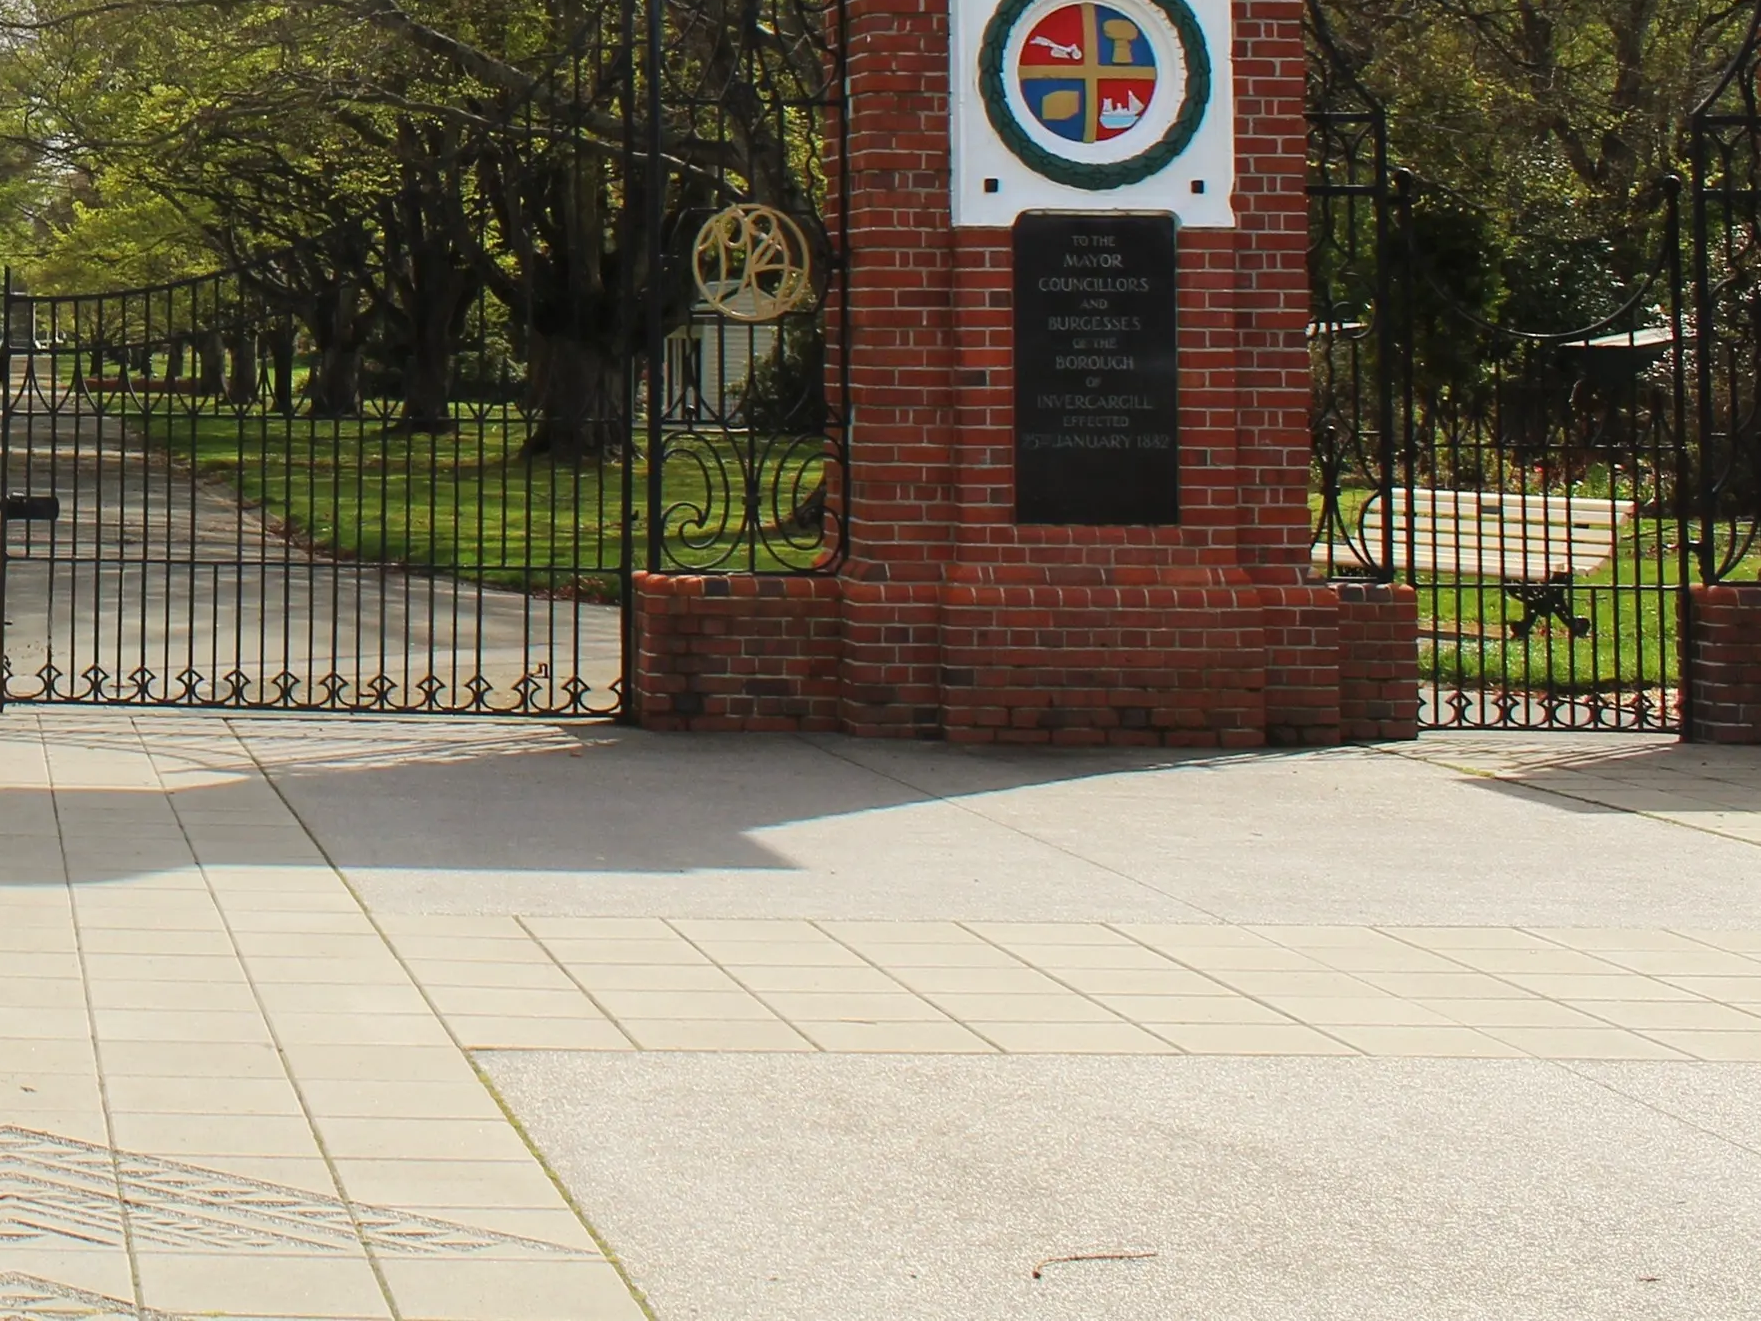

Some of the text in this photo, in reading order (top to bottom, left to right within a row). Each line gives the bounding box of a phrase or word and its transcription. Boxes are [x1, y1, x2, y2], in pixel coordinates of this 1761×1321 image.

[1071, 235, 1115, 247] TO THE
[1064, 254, 1123, 268] MAYOR
[1038, 278, 1149, 292] COUNCILLORS
[1080, 299, 1108, 309] AND
[1048, 316, 1141, 331] BURGESSES
[1072, 337, 1118, 349] OF THE
[1056, 356, 1134, 370] BOROUGH
[1086, 377, 1102, 387] OF
[1037, 395, 1153, 409] INVERCARGILL
[1063, 416, 1129, 427] EFFECTED
[1053, 434, 1132, 449] JANUARY
